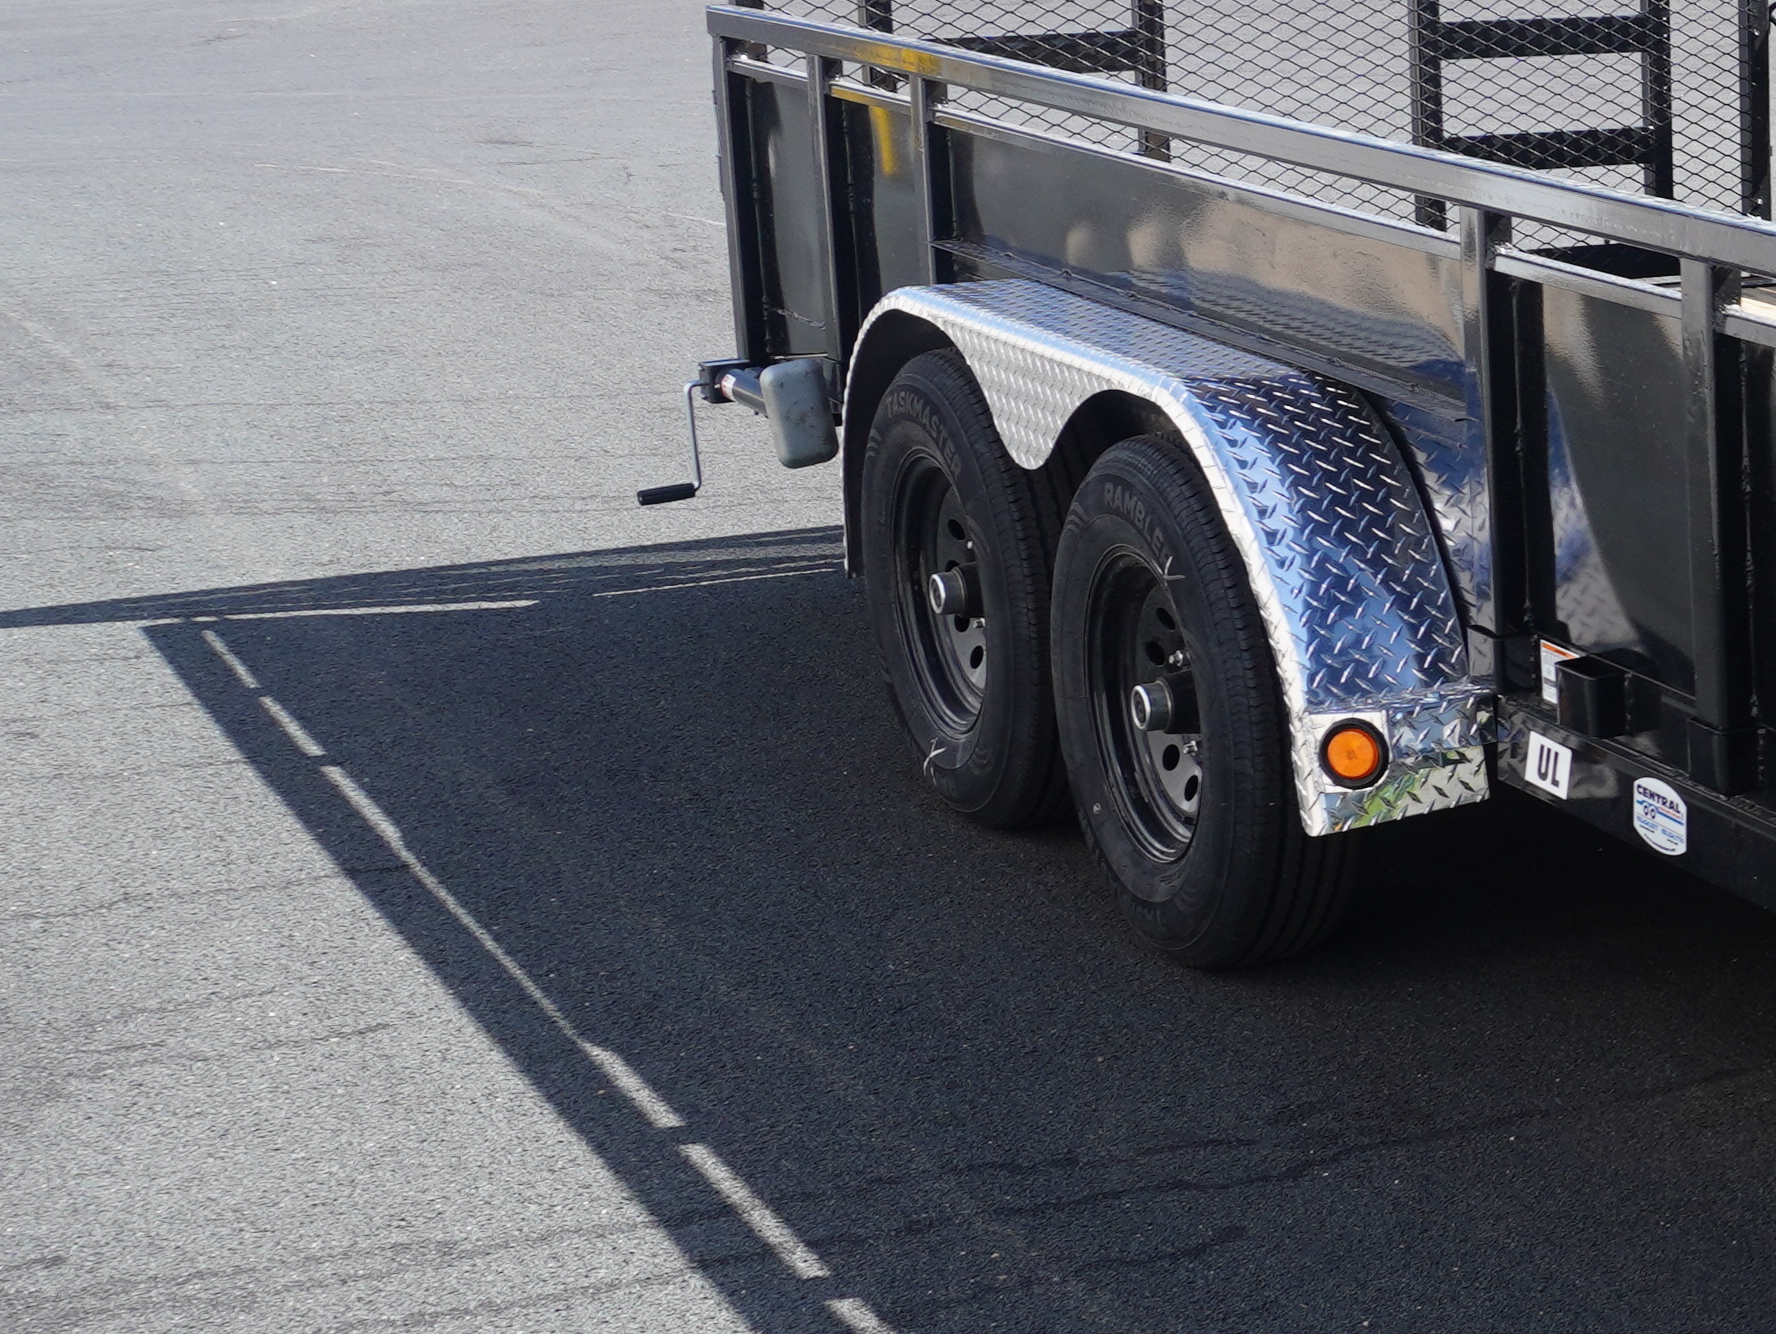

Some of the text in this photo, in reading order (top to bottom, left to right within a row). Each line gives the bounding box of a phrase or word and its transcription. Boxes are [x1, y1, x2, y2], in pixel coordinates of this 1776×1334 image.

[885, 390, 962, 481] TASKMASTER
[1537, 743, 1562, 789] UL
[1636, 783, 1681, 814] CENTRAL
